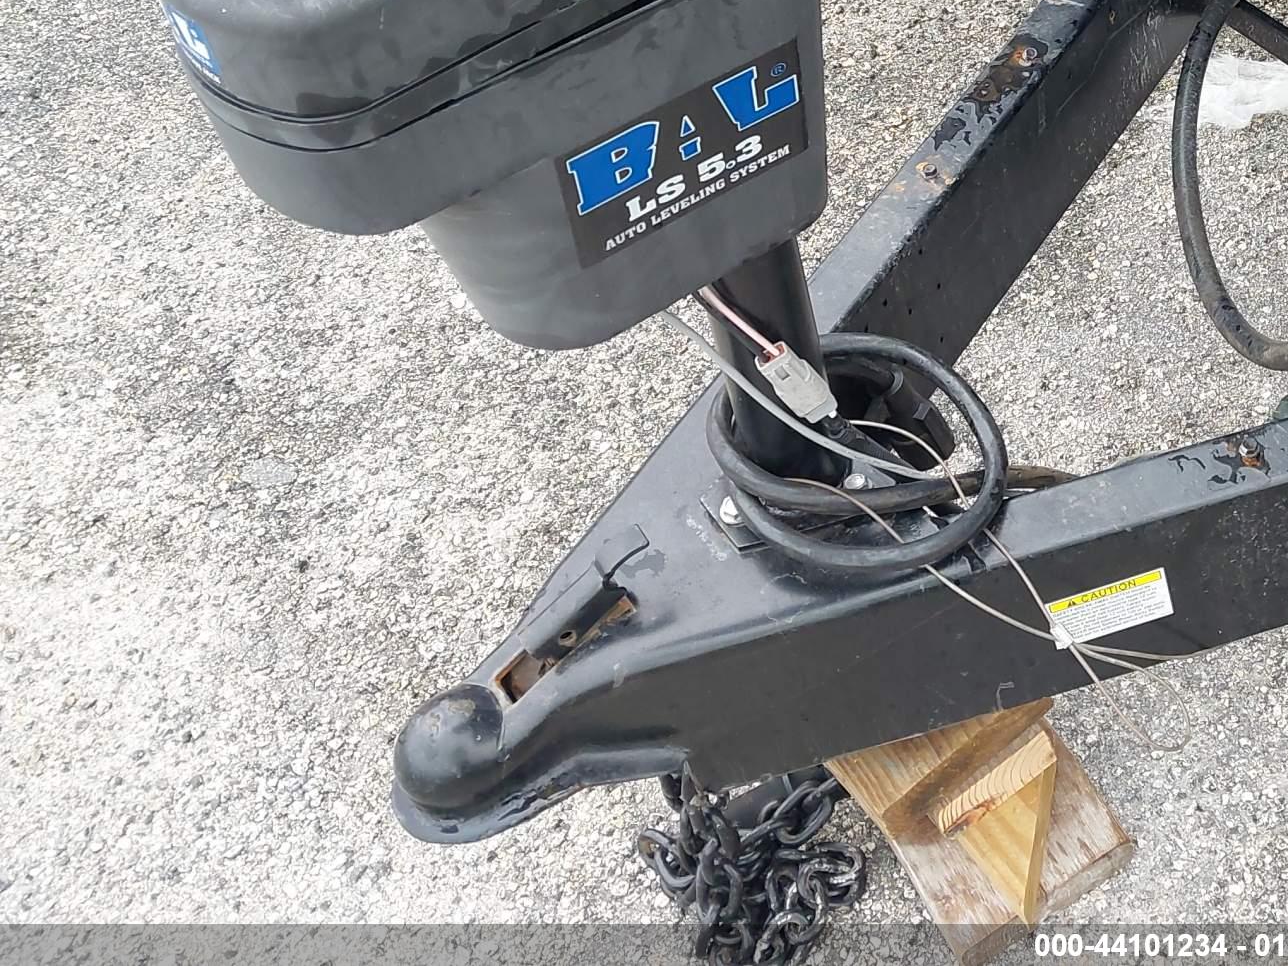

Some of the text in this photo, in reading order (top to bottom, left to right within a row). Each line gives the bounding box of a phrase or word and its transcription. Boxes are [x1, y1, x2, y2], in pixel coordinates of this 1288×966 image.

[604, 144, 791, 251] AUTO LEVELING SYSTEM
[625, 135, 763, 222] LS 5.3
[1080, 579, 1138, 604] CAUTION
